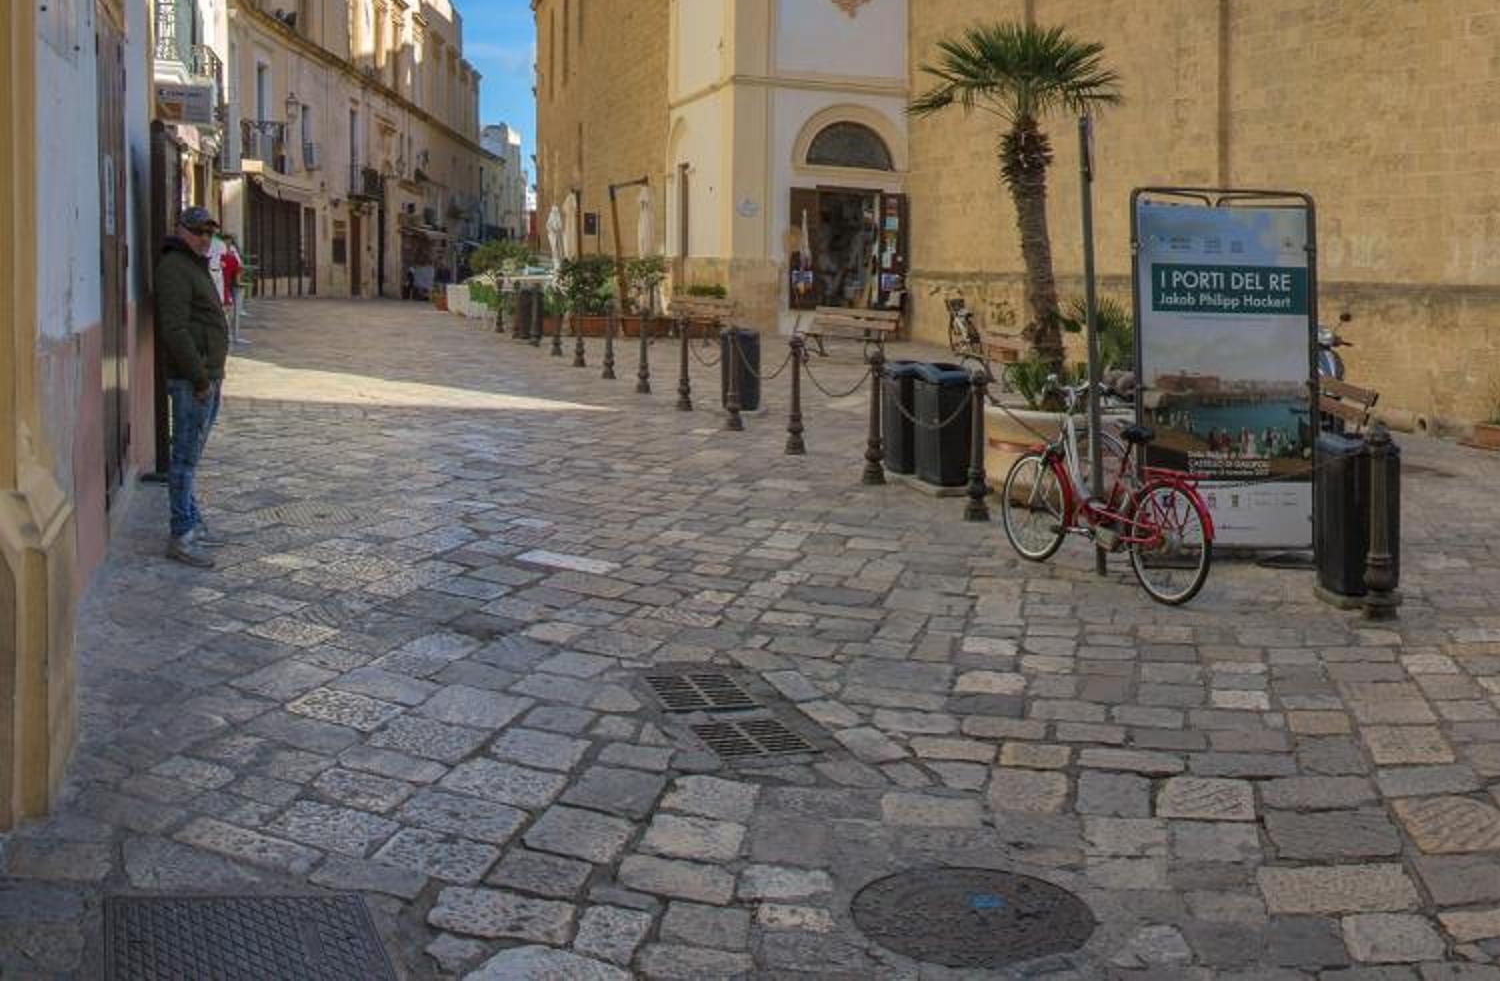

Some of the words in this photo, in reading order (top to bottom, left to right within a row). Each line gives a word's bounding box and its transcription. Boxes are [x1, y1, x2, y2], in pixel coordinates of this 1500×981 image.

[1161, 271, 1166, 289] I
[1172, 271, 1225, 290] PORTI
[1231, 273, 1264, 291] DEL
[1269, 274, 1291, 293] RE
[1160, 293, 1196, 307] Jakob
[1200, 294, 1240, 310] Philipp
